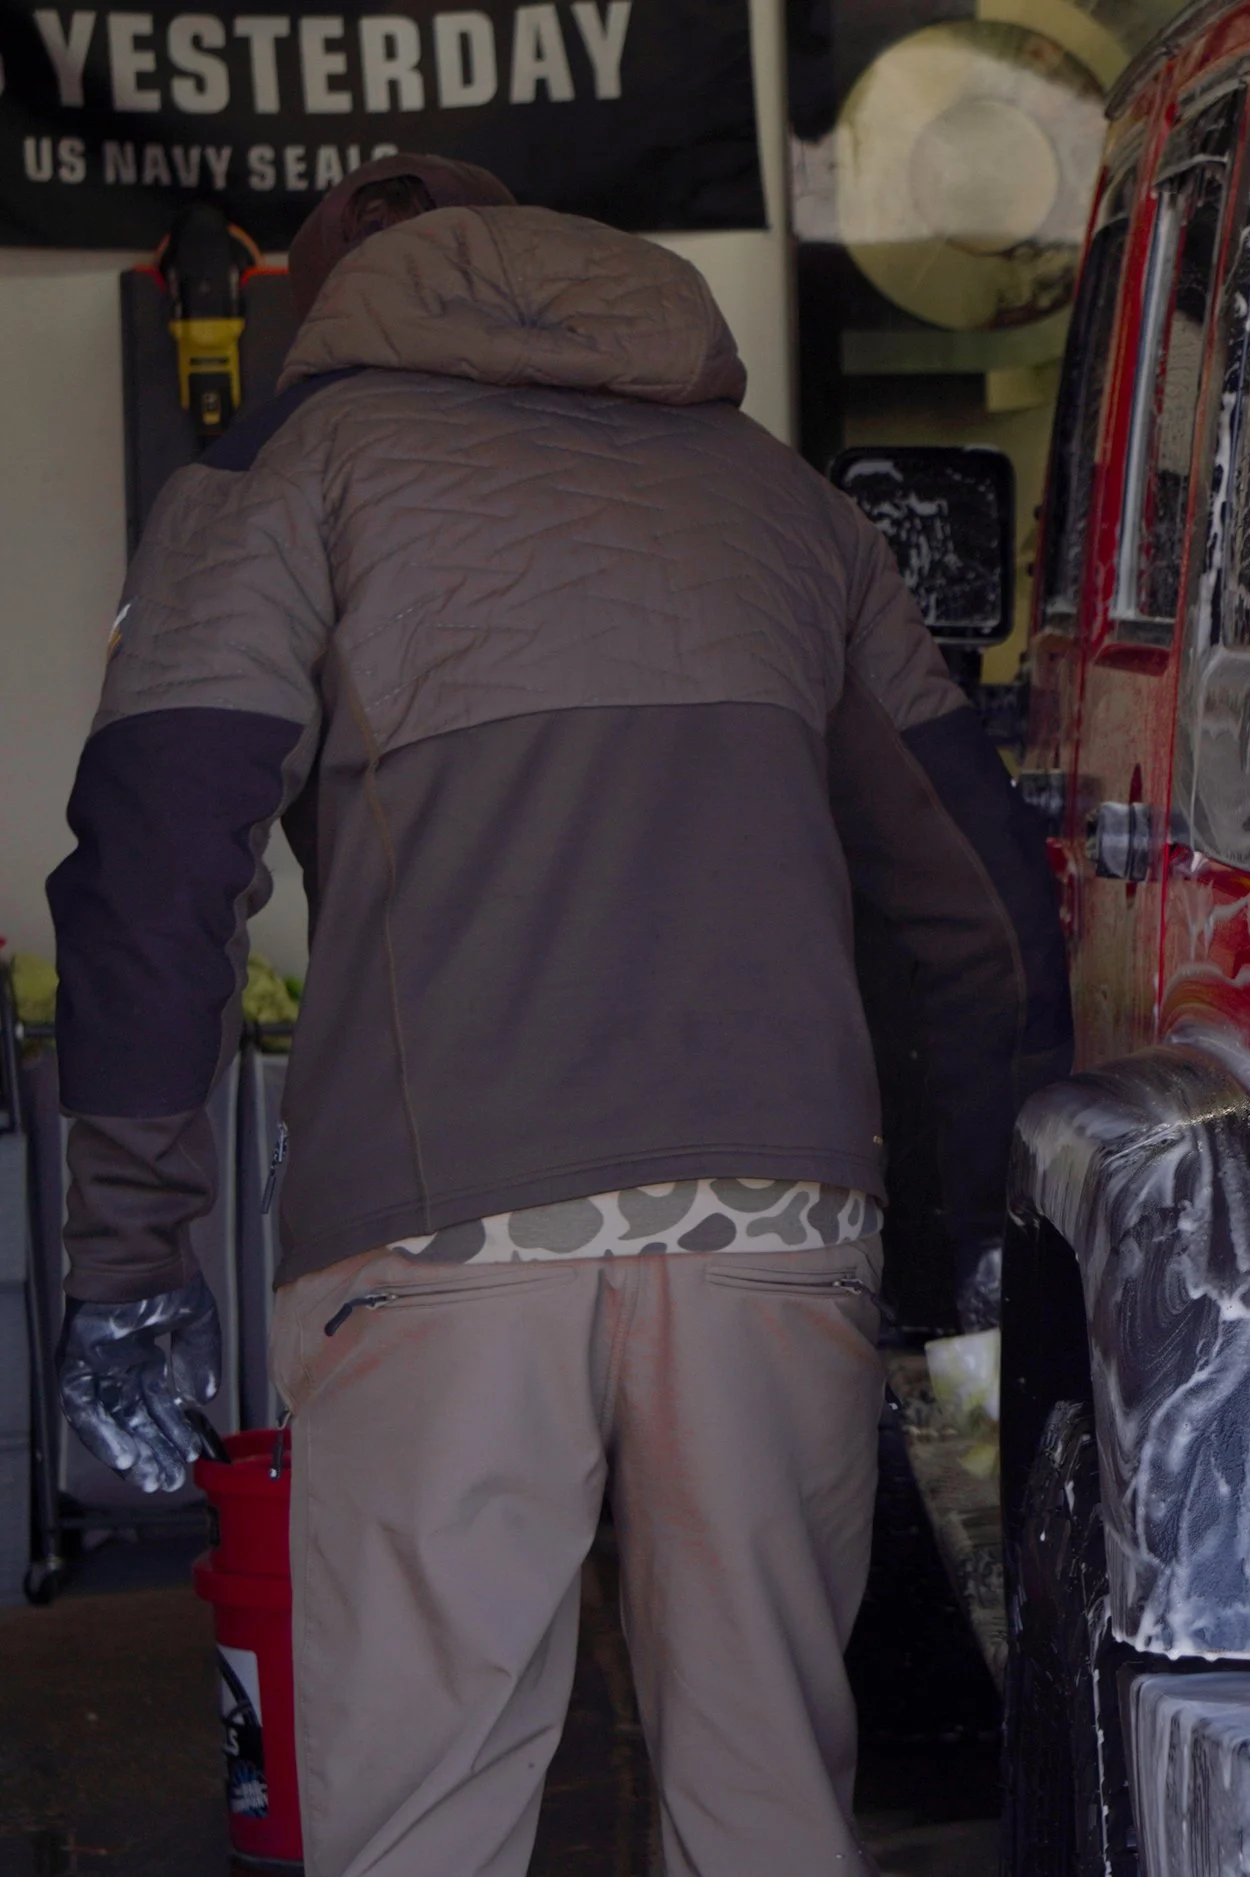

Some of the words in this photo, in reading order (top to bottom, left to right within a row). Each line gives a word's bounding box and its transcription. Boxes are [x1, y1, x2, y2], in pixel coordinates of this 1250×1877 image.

[34, 1, 632, 114] YESTERDAY
[23, 137, 87, 183] US
[104, 141, 232, 191] NAVY
[247, 144, 399, 191] SEA
